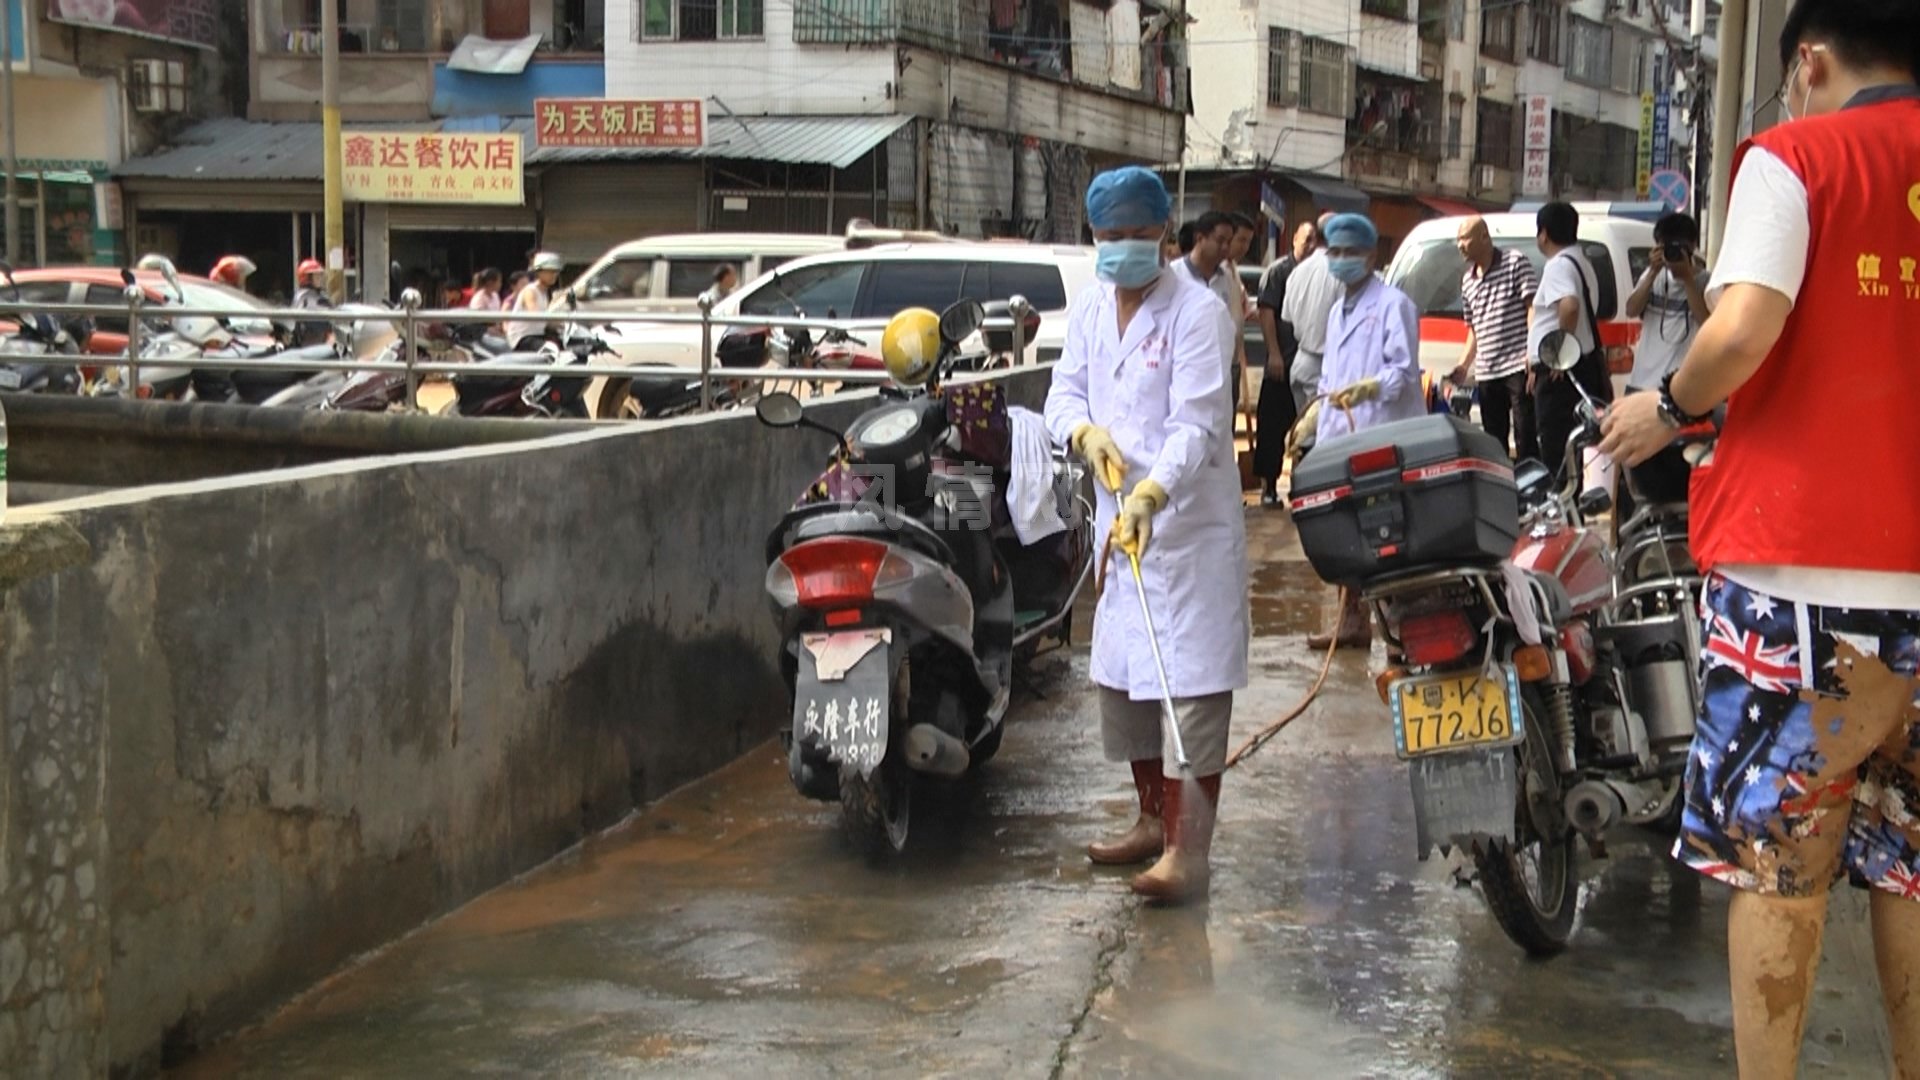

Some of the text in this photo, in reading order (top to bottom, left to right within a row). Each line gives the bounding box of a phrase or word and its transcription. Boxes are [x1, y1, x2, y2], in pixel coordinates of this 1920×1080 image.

[543, 104, 656, 135] 为天饭店
[345, 135, 513, 171] 鑫达餐饮店
[1857, 280, 1889, 296] Xin
[804, 697, 881, 742] 永隆车行
[1409, 705, 1504, 748] 772J6
